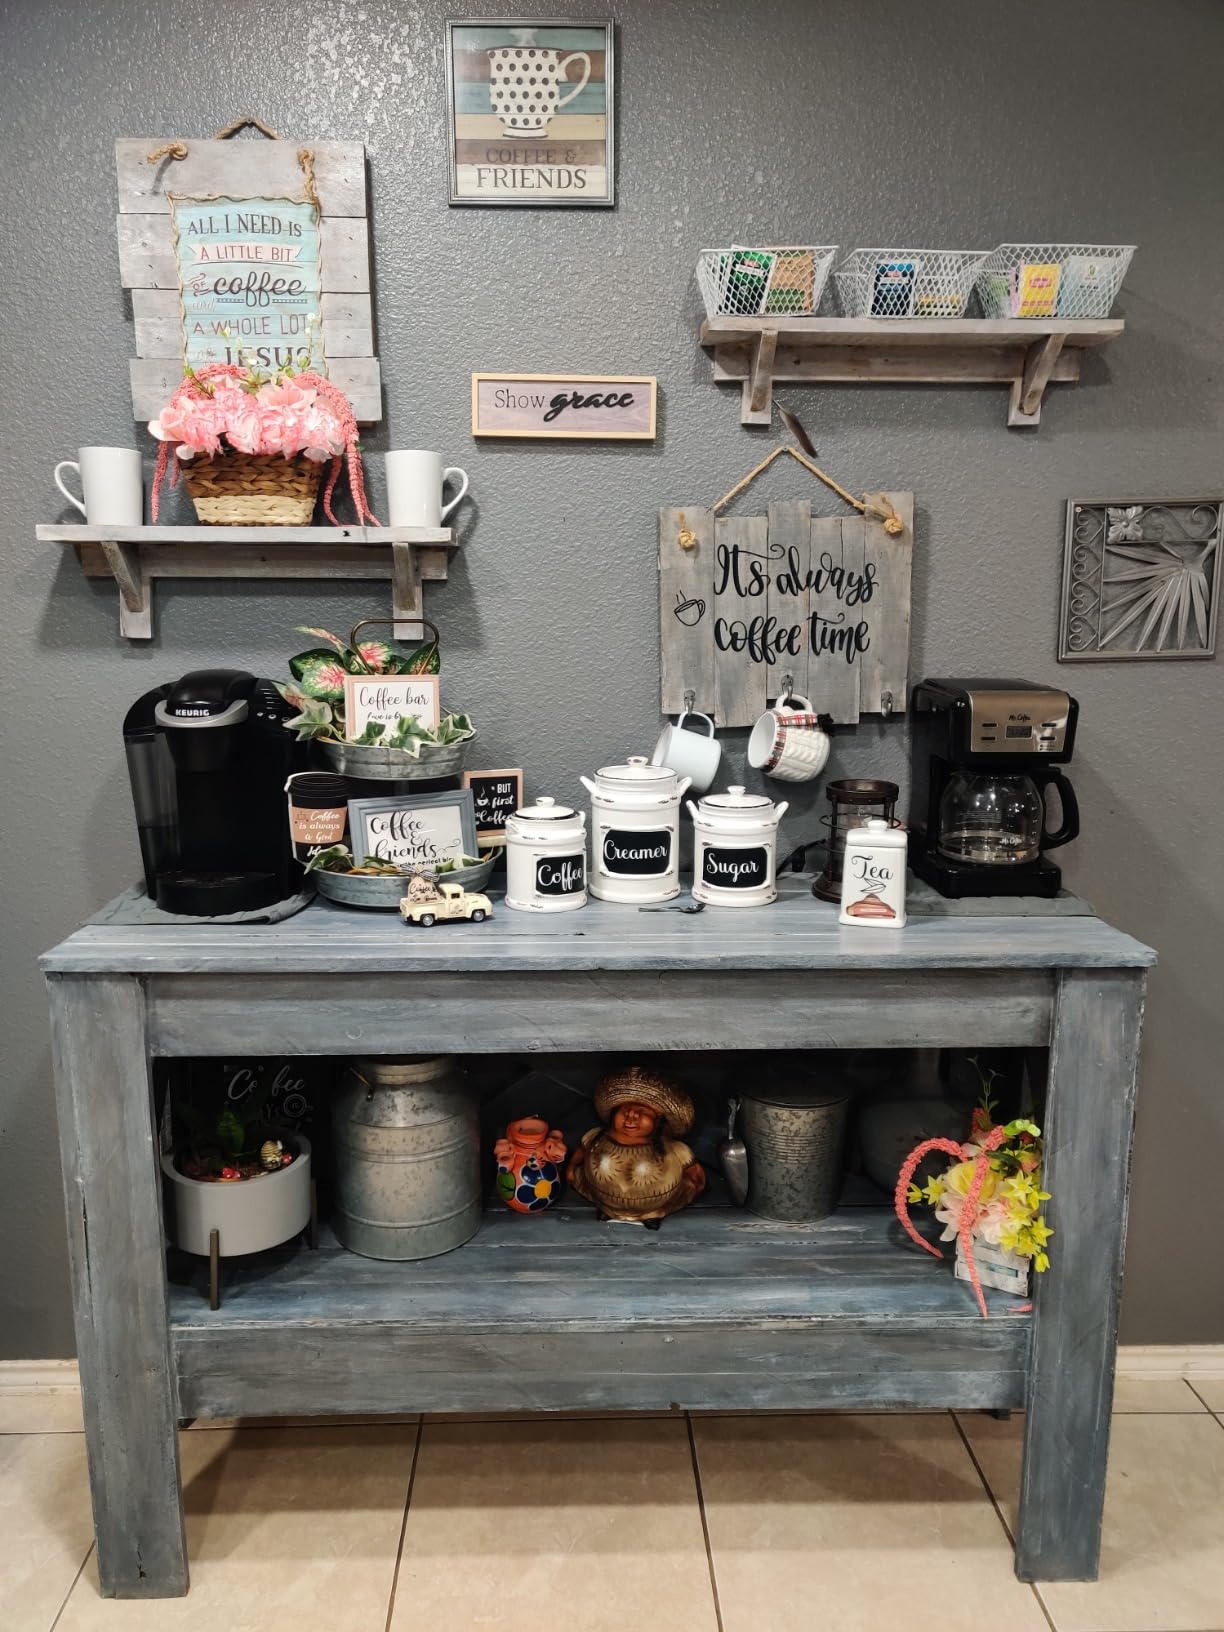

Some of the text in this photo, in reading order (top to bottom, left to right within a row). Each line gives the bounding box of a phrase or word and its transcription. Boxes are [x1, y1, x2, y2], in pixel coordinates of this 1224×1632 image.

[486, 150, 577, 164] COFFEE &
[476, 167, 587, 190] FRIENDS
[187, 214, 302, 237] ALL I NEED IS
[200, 245, 292, 261] A LITTLE BIT
[213, 271, 307, 307] coffee
[193, 313, 308, 336] A WHOLE LOT
[494, 389, 635, 423] Show grace
[776, 545, 879, 606] always
[806, 610, 871, 664] time
[359, 686, 430, 710] Coffee bar
[497, 782, 512, 793] BUT
[491, 794, 514, 809] first
[299, 822, 340, 830] is always
[310, 810, 341, 822] Coffee
[370, 811, 425, 841] Coffee
[410, 831, 422, 846] &
[604, 839, 668, 860] Creamer
[537, 861, 583, 891] Coffee
[706, 852, 759, 882] Sugar
[851, 855, 893, 880] Tea
